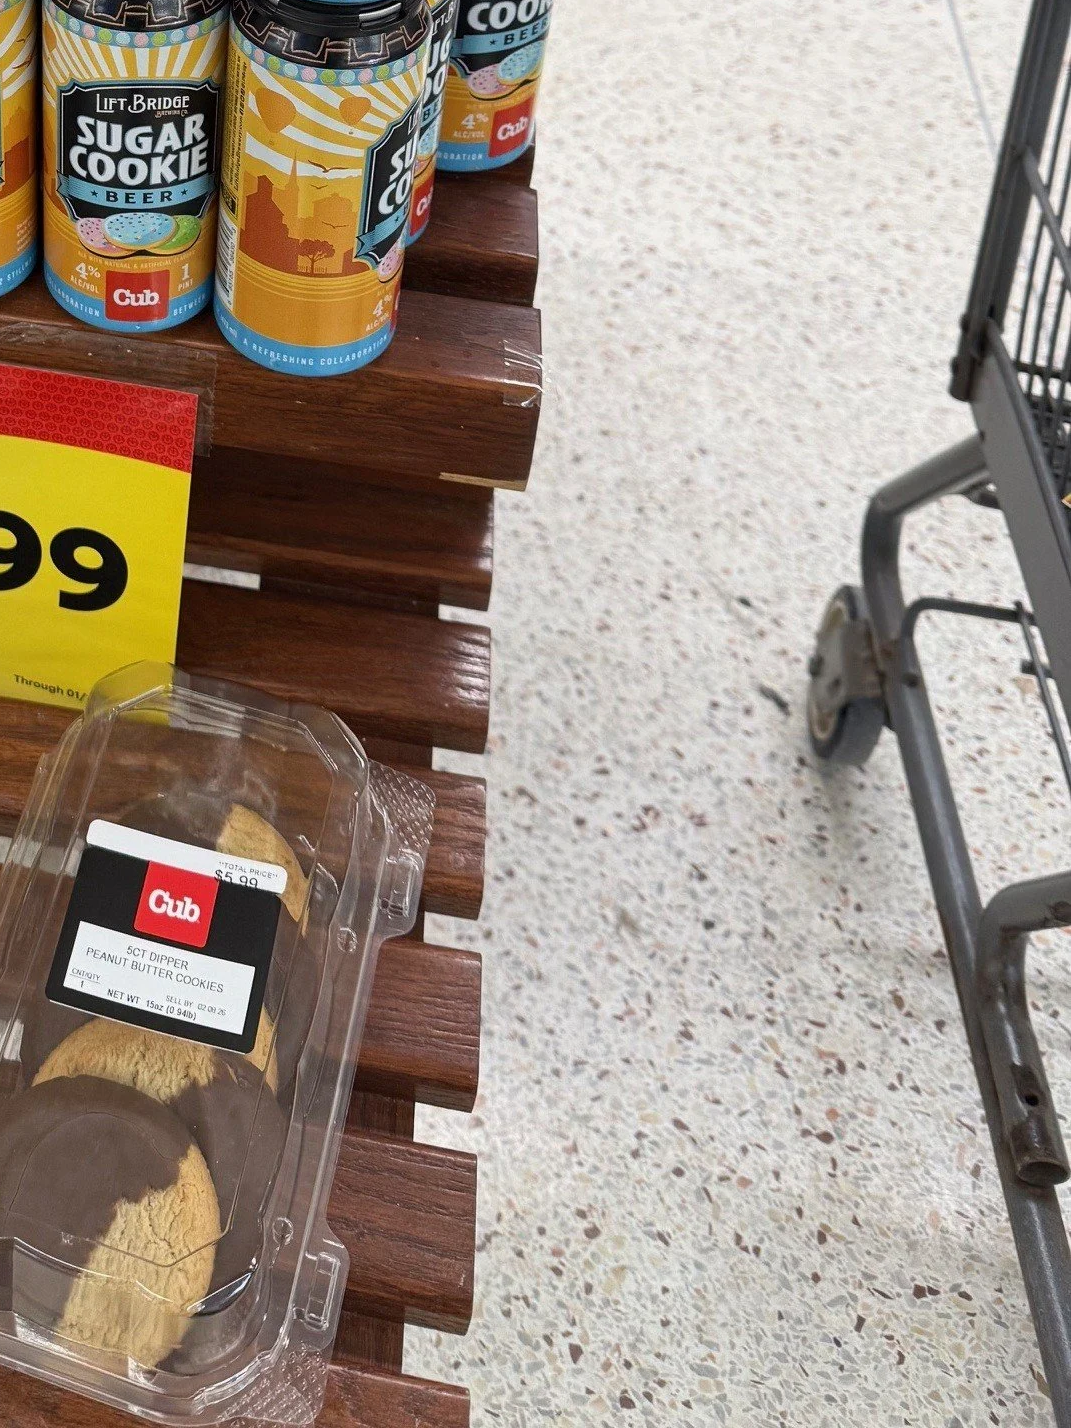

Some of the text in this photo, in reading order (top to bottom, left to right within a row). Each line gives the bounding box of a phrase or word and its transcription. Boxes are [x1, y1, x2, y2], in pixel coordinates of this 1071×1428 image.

[96, 93, 190, 114] LIFT BRIDGE
[461, 113, 489, 129] 4%
[497, 116, 528, 141] Cub
[77, 113, 205, 156] SUGAR
[69, 139, 208, 187] COOKIE
[106, 189, 173, 205] BEER
[76, 263, 100, 280] 4%
[182, 264, 189, 280] 1
[71, 275, 99, 293] ALC/VOL
[178, 278, 193, 291] PINT
[113, 289, 159, 306] Cub
[243, 334, 388, 366] A REFRESHING COLLABORATION
[14, 674, 64, 695] Through
[149, 889, 201, 922] Cub
[126, 945, 189, 970] 5CT DIPPER
[71, 968, 100, 982] CNT/QTY
[86, 947, 224, 993] PEANUT BUTTER COOKIES
[107, 988, 163, 1011] NET WT 15oz
[166, 995, 183, 1005] SELL
